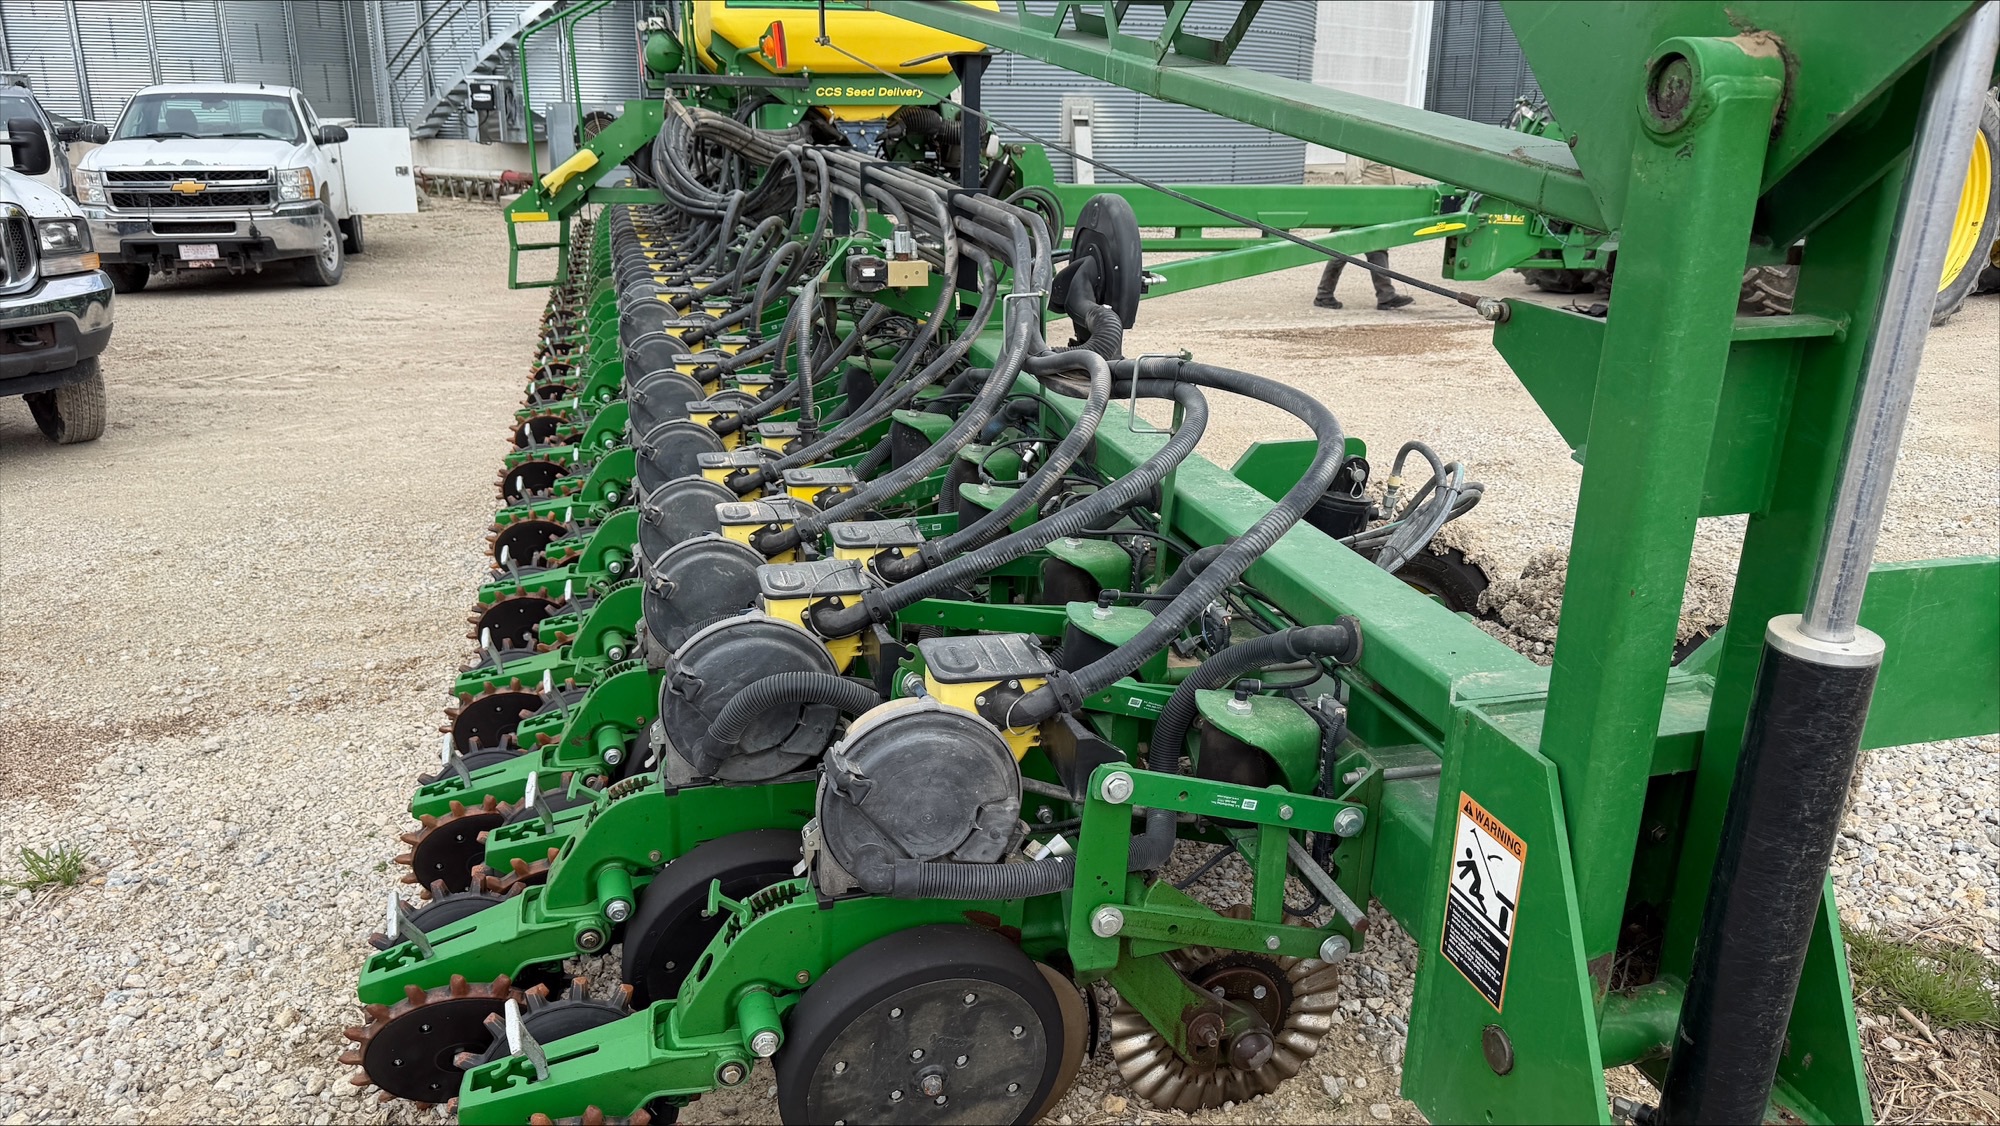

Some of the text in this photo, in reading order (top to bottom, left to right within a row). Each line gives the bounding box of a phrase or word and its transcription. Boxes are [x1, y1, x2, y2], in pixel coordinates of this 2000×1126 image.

[815, 87, 924, 98] CCS Seed Delivery
[1475, 807, 1522, 857] WARNING
